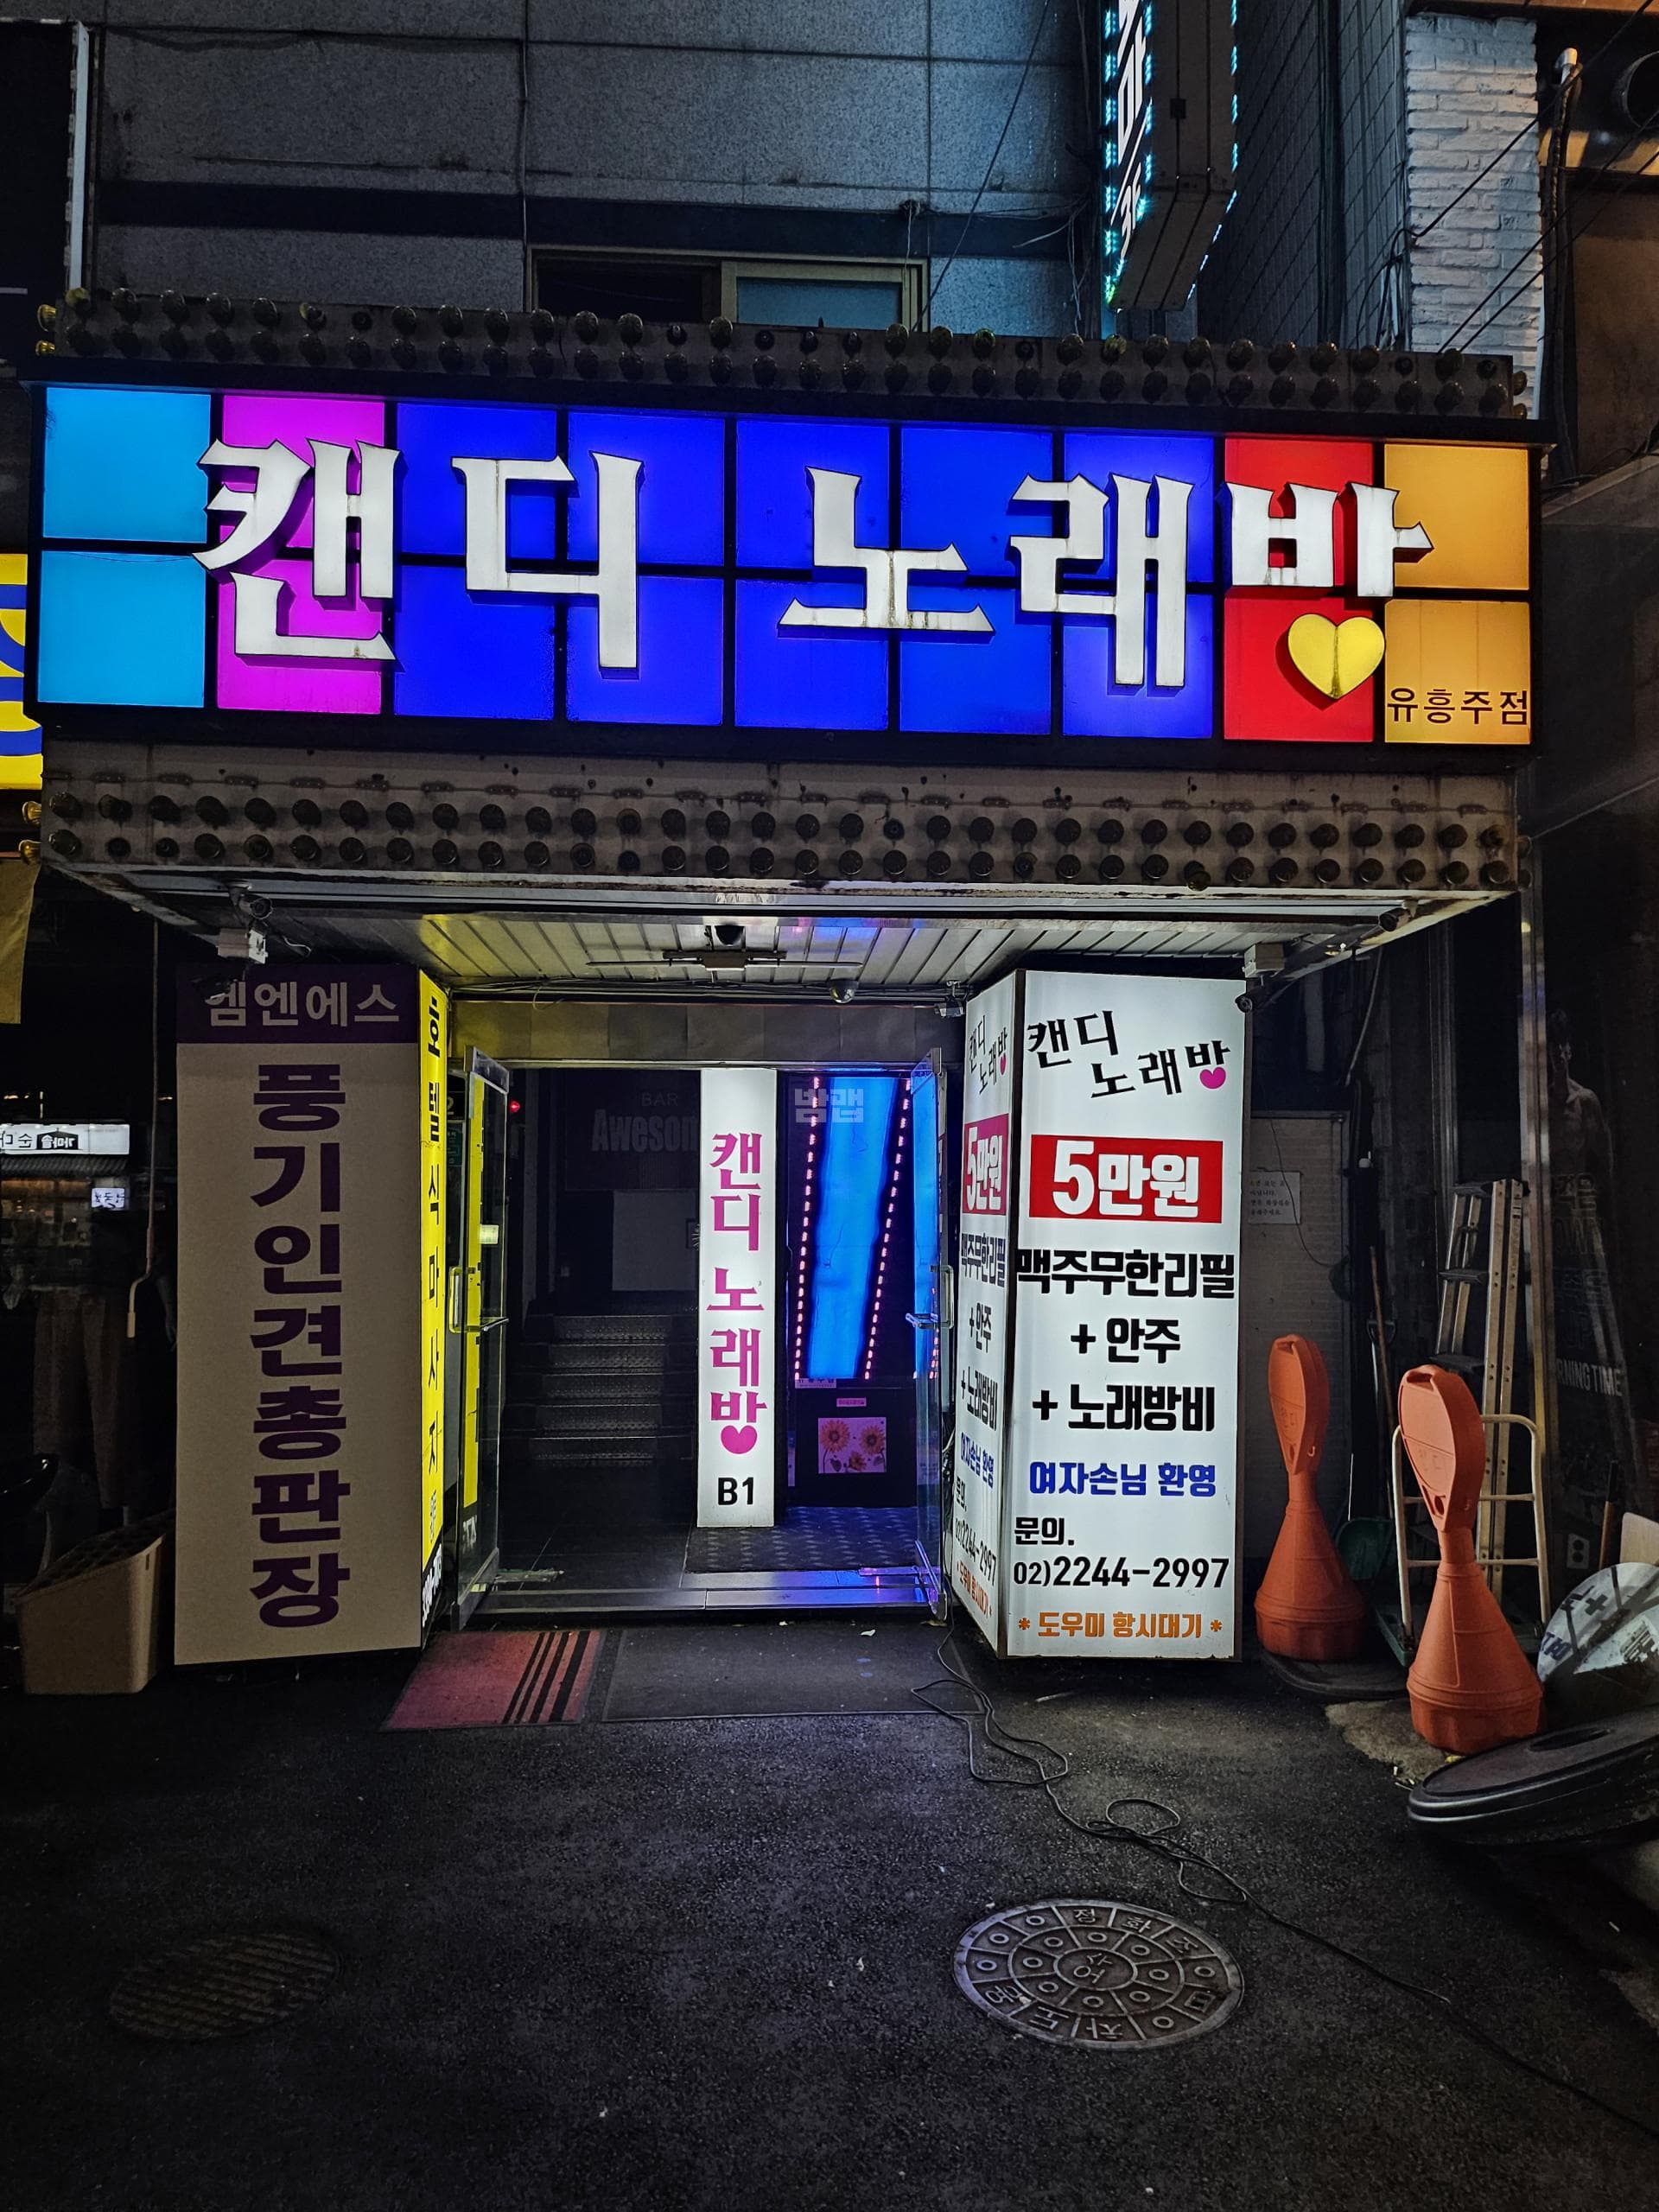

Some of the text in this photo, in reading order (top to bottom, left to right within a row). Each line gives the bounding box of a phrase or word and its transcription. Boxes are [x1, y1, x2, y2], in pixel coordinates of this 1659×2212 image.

[193, 438, 1434, 700] 캔디 노래방
[1387, 689, 1530, 727] 유흥주점
[969, 1014, 986, 1074] 캔디
[1027, 1010, 1231, 1098] 캔디 노래방
[641, 1092, 678, 1107] BAR
[710, 1133, 761, 1251] 캔디
[966, 1126, 1003, 1210] 5만원
[1052, 1140, 1199, 1218] 5만원
[961, 1232, 1006, 1288] 맥주무한리필
[1017, 1249, 1235, 1300] 맥주무한리필
[976, 1302, 992, 1353] 안주
[1106, 1317, 1181, 1364] 안주
[967, 1366, 998, 1431] 노래방비
[1591, 1363, 1623, 1397] TIME
[1068, 1384, 1215, 1432] 노래방비
[960, 1431, 994, 1489] 여자손님 환영
[1029, 1461, 1216, 1497] 여자손님 환영
[717, 1477, 755, 1505] B1
[1014, 1517, 1074, 1546] 문의.
[1014, 1556, 1230, 1588] 02)2244-2997
[1038, 1612, 1202, 1639] 도우미 항시대기
